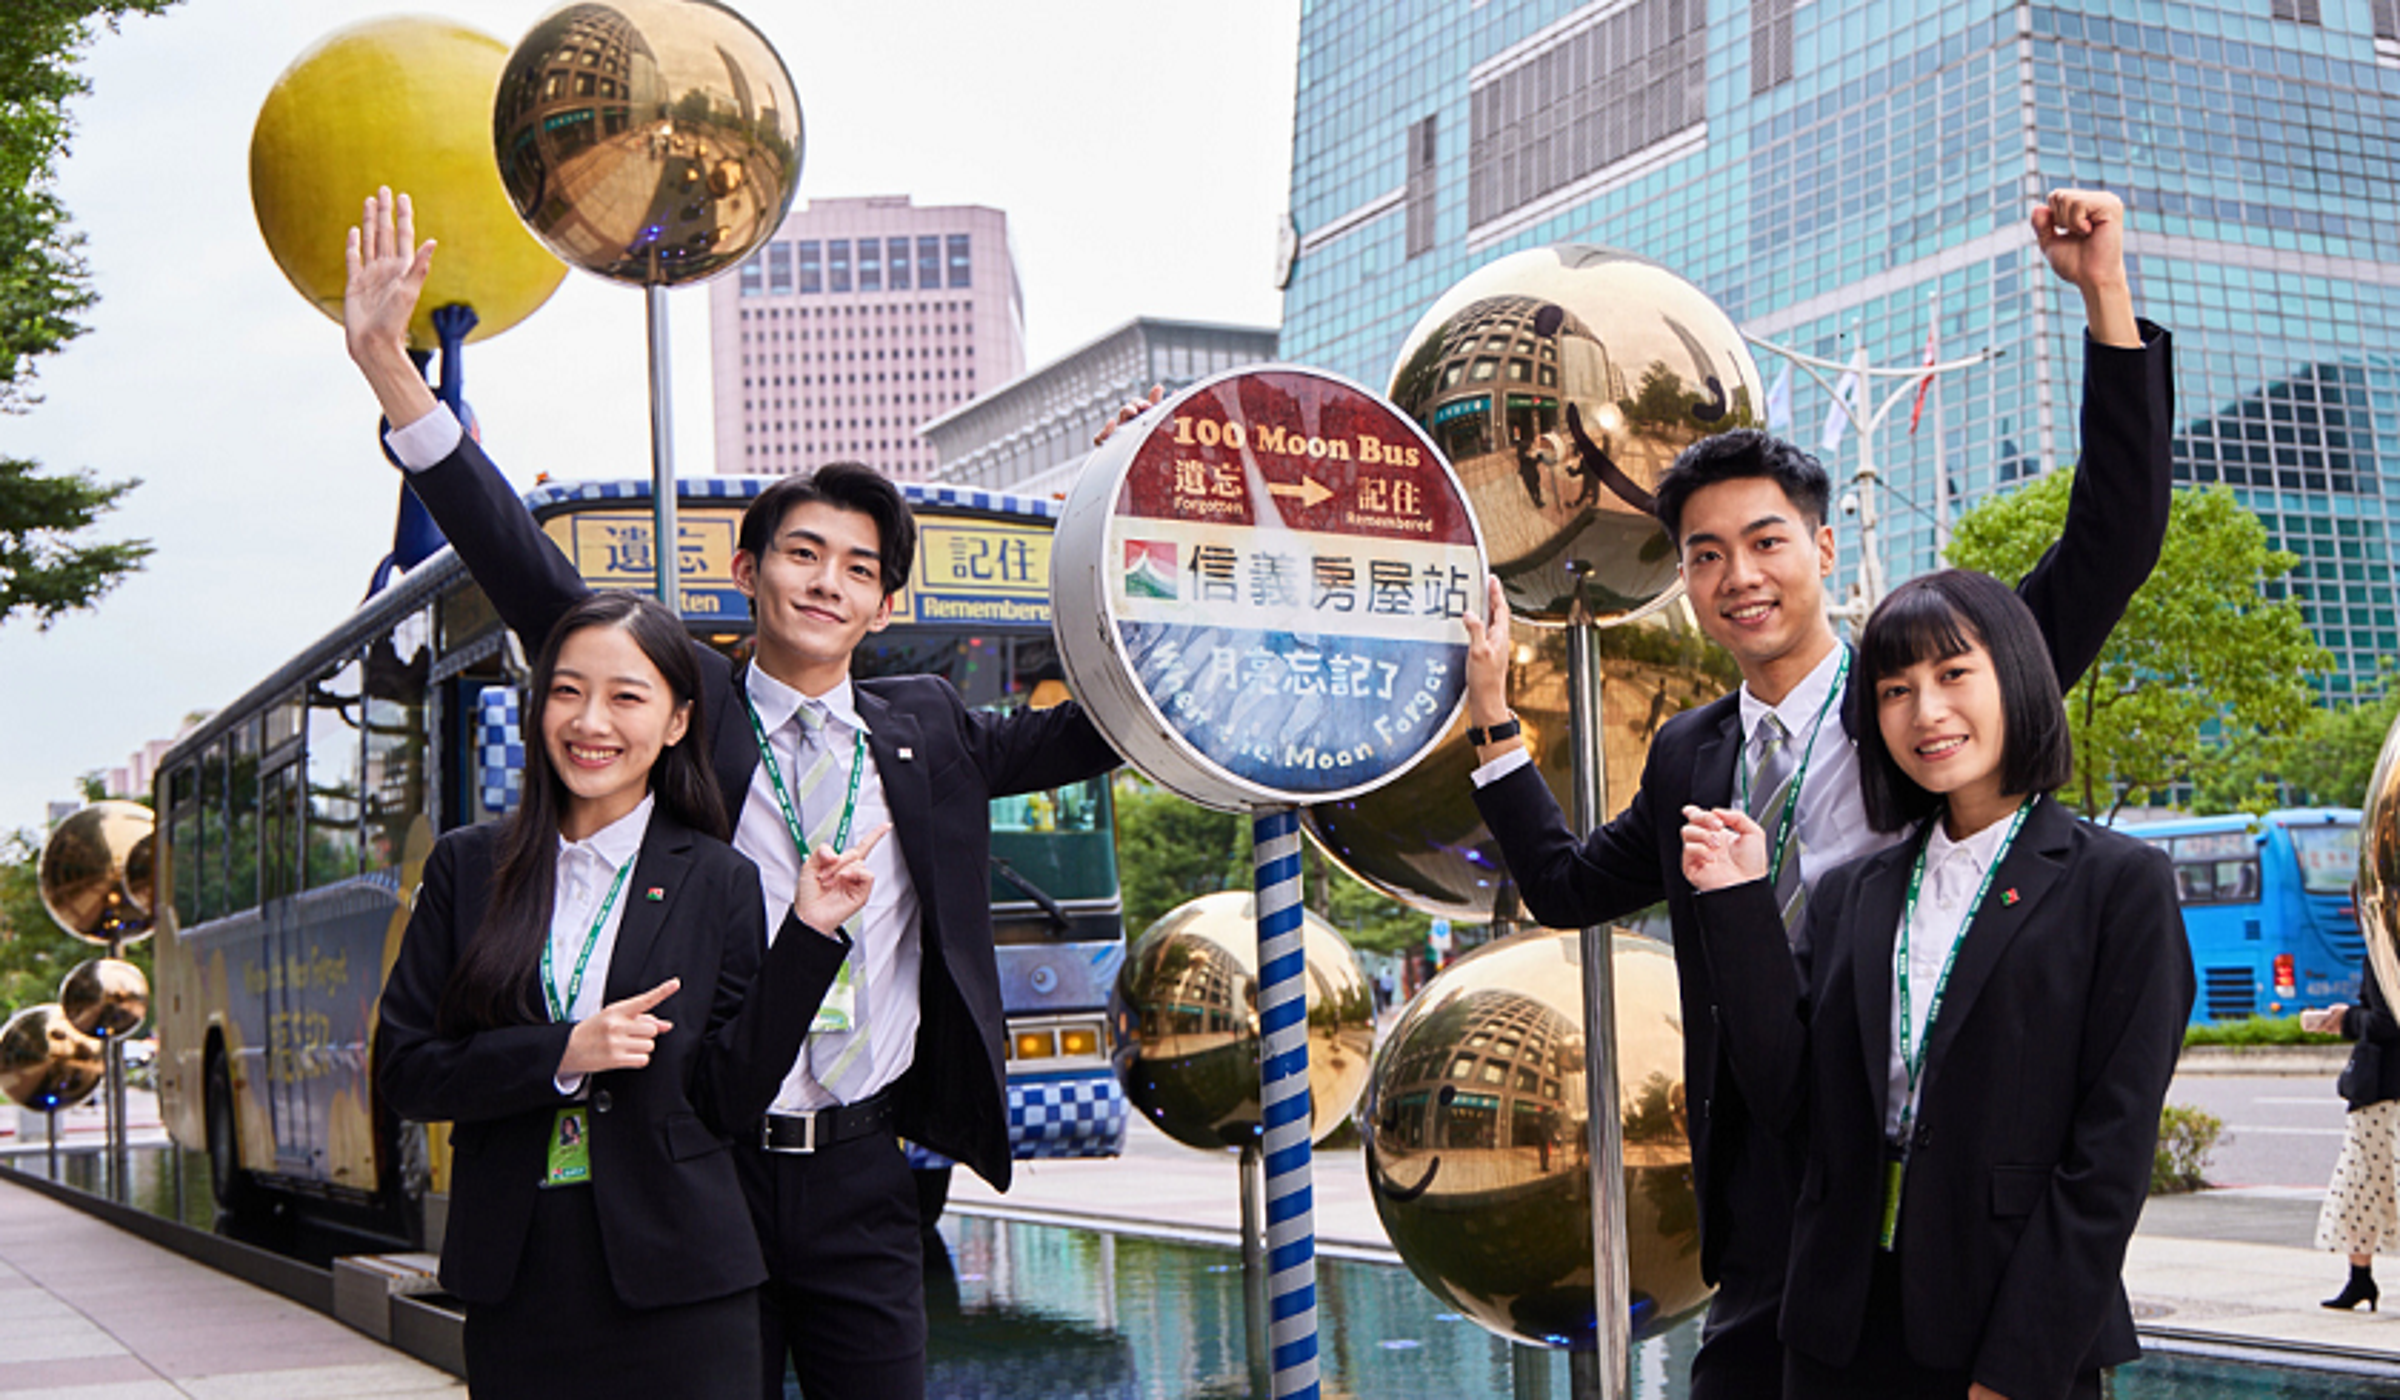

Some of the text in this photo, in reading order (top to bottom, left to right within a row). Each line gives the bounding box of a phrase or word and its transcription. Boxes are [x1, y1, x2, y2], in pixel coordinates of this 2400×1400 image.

[1173, 416, 1420, 467] 100 Moon Bus
[1174, 459, 1243, 496] 遺忘
[1358, 476, 1421, 515] 記住
[1174, 495, 1243, 515] Forgotten
[1346, 510, 1432, 533] Remembered
[949, 536, 1039, 583] 記住
[1188, 544, 1470, 619] 信義房屋站
[924, 597, 1051, 621] Remembere
[1210, 645, 1398, 700] 月亮忘記了
[1285, 744, 1375, 770] Moon
[1373, 657, 1448, 746] Forgot
